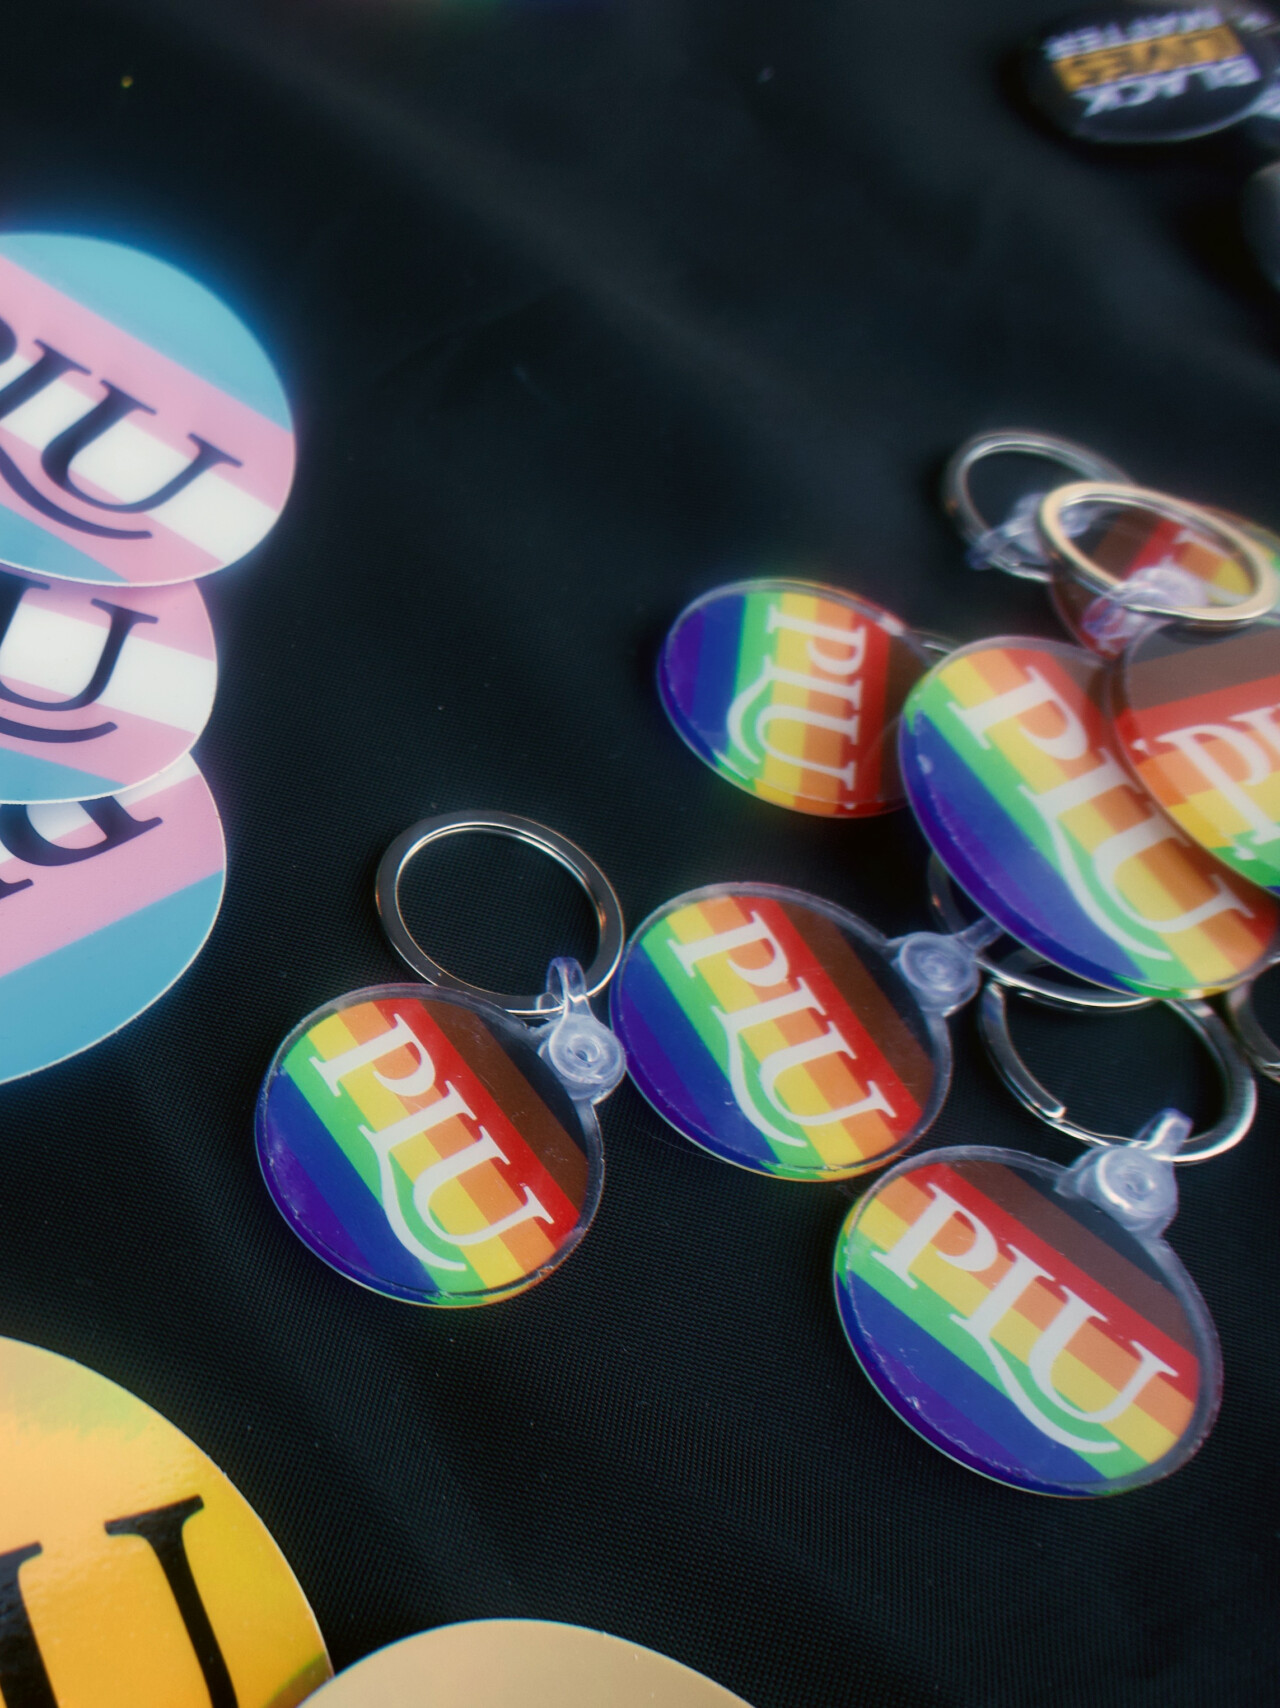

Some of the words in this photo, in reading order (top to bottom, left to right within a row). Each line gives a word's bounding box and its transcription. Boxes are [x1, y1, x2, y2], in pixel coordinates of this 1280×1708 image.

[1073, 54, 1261, 117] BLACK
[726, 604, 867, 792] PLU
[948, 666, 1256, 962] PLU
[308, 1013, 554, 1272] PLU
[666, 910, 898, 1147] PLU
[871, 1182, 1179, 1453] PLU
